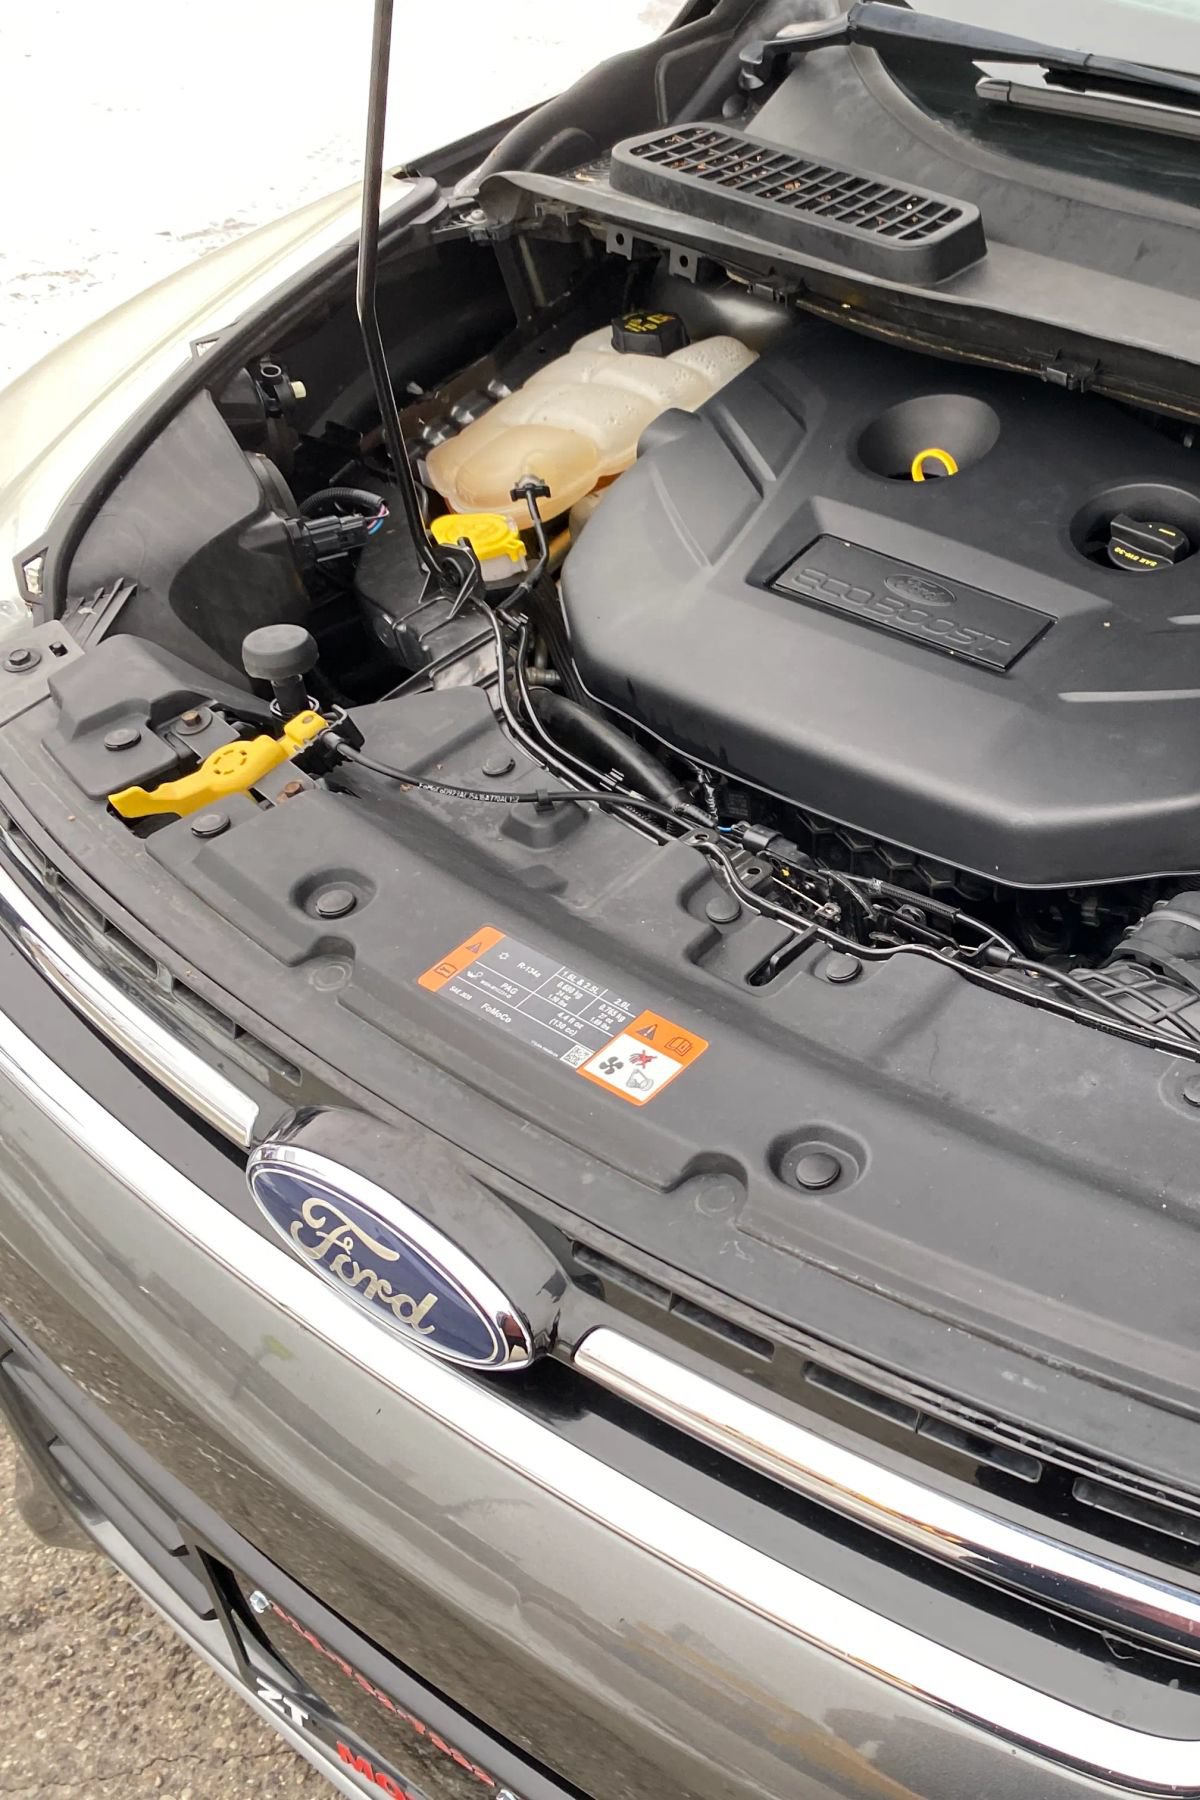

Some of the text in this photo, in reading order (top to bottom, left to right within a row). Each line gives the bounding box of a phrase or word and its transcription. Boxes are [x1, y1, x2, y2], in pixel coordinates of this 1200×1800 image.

[792, 567, 1011, 652] ECOBOOST
[517, 961, 541, 978] R-134a
[562, 970, 577, 983] 1.6L
[500, 982, 518, 995] PAG
[480, 1002, 511, 1023] FoMoCo
[613, 998, 631, 1010] 2.0L
[290, 1198, 438, 1335] Ford
[256, 1677, 309, 1727] ZT
